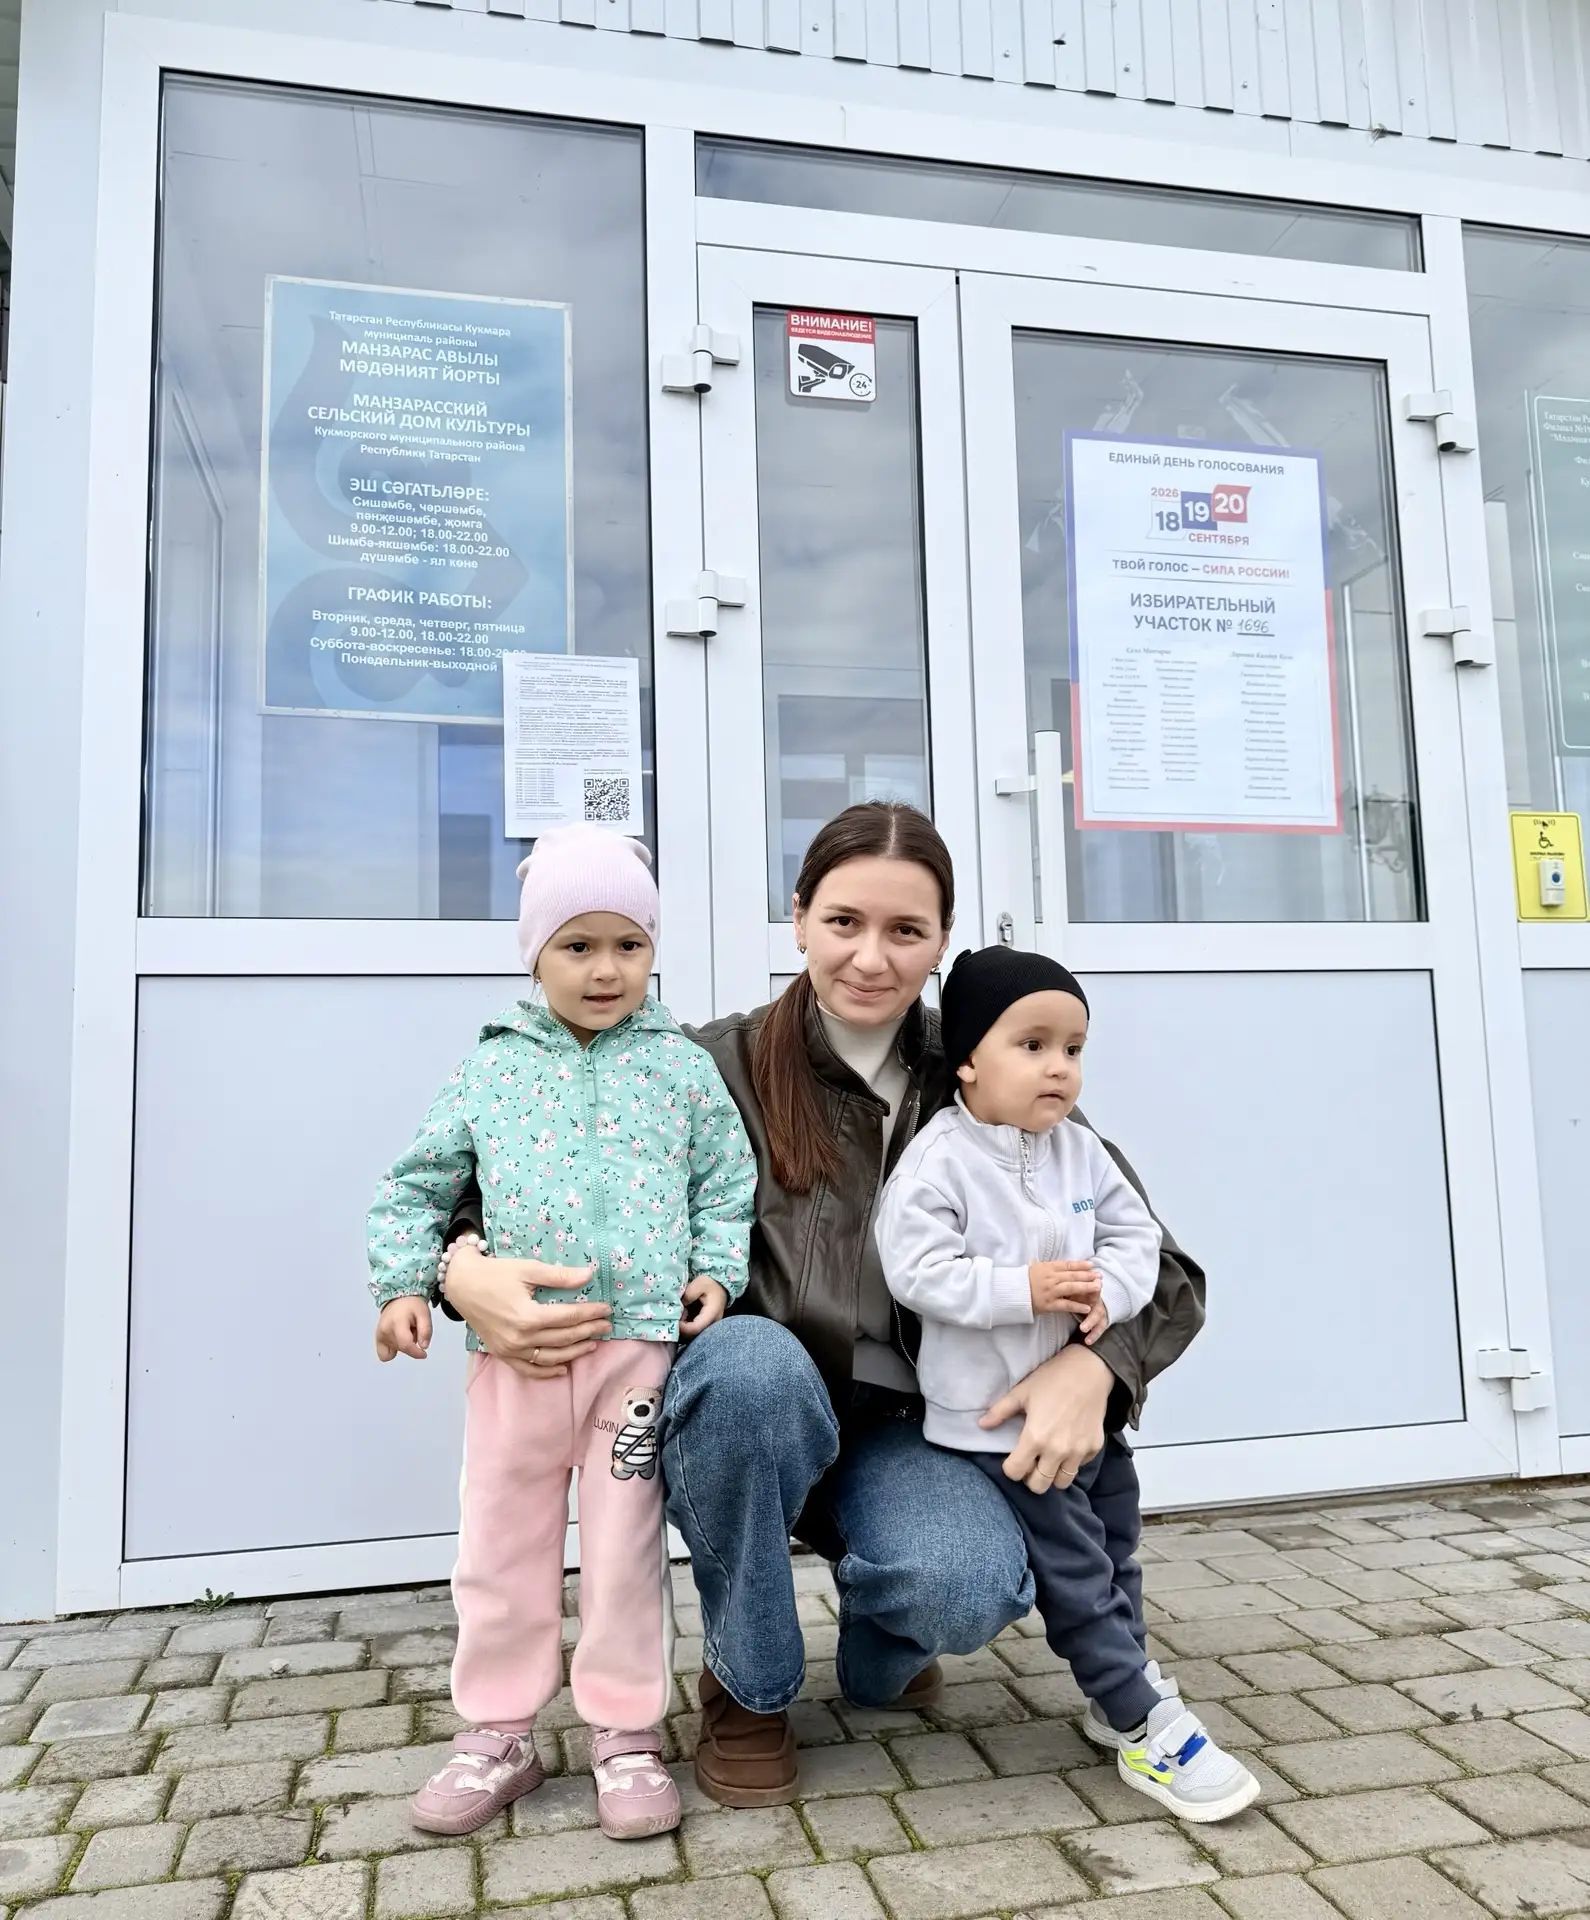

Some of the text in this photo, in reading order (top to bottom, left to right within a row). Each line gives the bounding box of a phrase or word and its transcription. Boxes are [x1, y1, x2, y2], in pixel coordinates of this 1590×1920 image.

[328, 311, 511, 338] Татарстан Республикасы Кукмара
[790, 314, 873, 333] ВНИМАНИЕ!
[364, 330, 478, 348] муниципаль районы
[342, 340, 499, 367] МАНЗАРАС АВЫЛЫ
[339, 358, 501, 386] МӘДӘНИЯТ ЙОРТЫ
[855, 380, 867, 389] 24
[353, 393, 488, 418] МАНЗАРАССКИЙ
[307, 406, 531, 438] СЕЛЬСКИЙ ДОМ КУЛЬТУРЫ
[314, 425, 526, 452] Кукморского муниципального района
[360, 443, 481, 463] Республики Татарстан
[1109, 452, 1285, 476] ЕДИНЫЙ ДЕНЬ ГОЛОСОВАНИЯ
[349, 478, 490, 502] ЭШ СӘГАТЬЛӘРЕ:
[1151, 487, 1179, 498] 2026
[352, 496, 416, 513] Сишәмбе,
[1155, 492, 1245, 532] 18 19 20
[350, 523, 488, 543] 9.00-12.00; 18.00-22.00
[1188, 532, 1249, 546] СЕНТЯБРЯ
[443, 543, 510, 558] 18.00-22.00
[430, 557, 446, 567] ял
[1112, 559, 1146, 571] ТВОЙ
[1149, 560, 1189, 573] ГОЛОС
[1202, 564, 1236, 576] СИЛА
[1238, 565, 1290, 579] РОССИИ!
[348, 586, 493, 609] ГРАФИК РАБОТЫ:
[1130, 592, 1276, 615] ИЗБИРАТЕЛЬНЫЙ
[312, 610, 526, 635] Вторник, среда, четверг, пятница
[1134, 614, 1271, 634] УЧАСТОК № 1696
[350, 625, 489, 645] 9.00-12.00, 18.00-22.00
[310, 636, 527, 659] Суббота-воскресенье: 18.00-2
[341, 652, 498, 672] Понедельник-выходной
[592, 1416, 620, 1434] LUXIN
